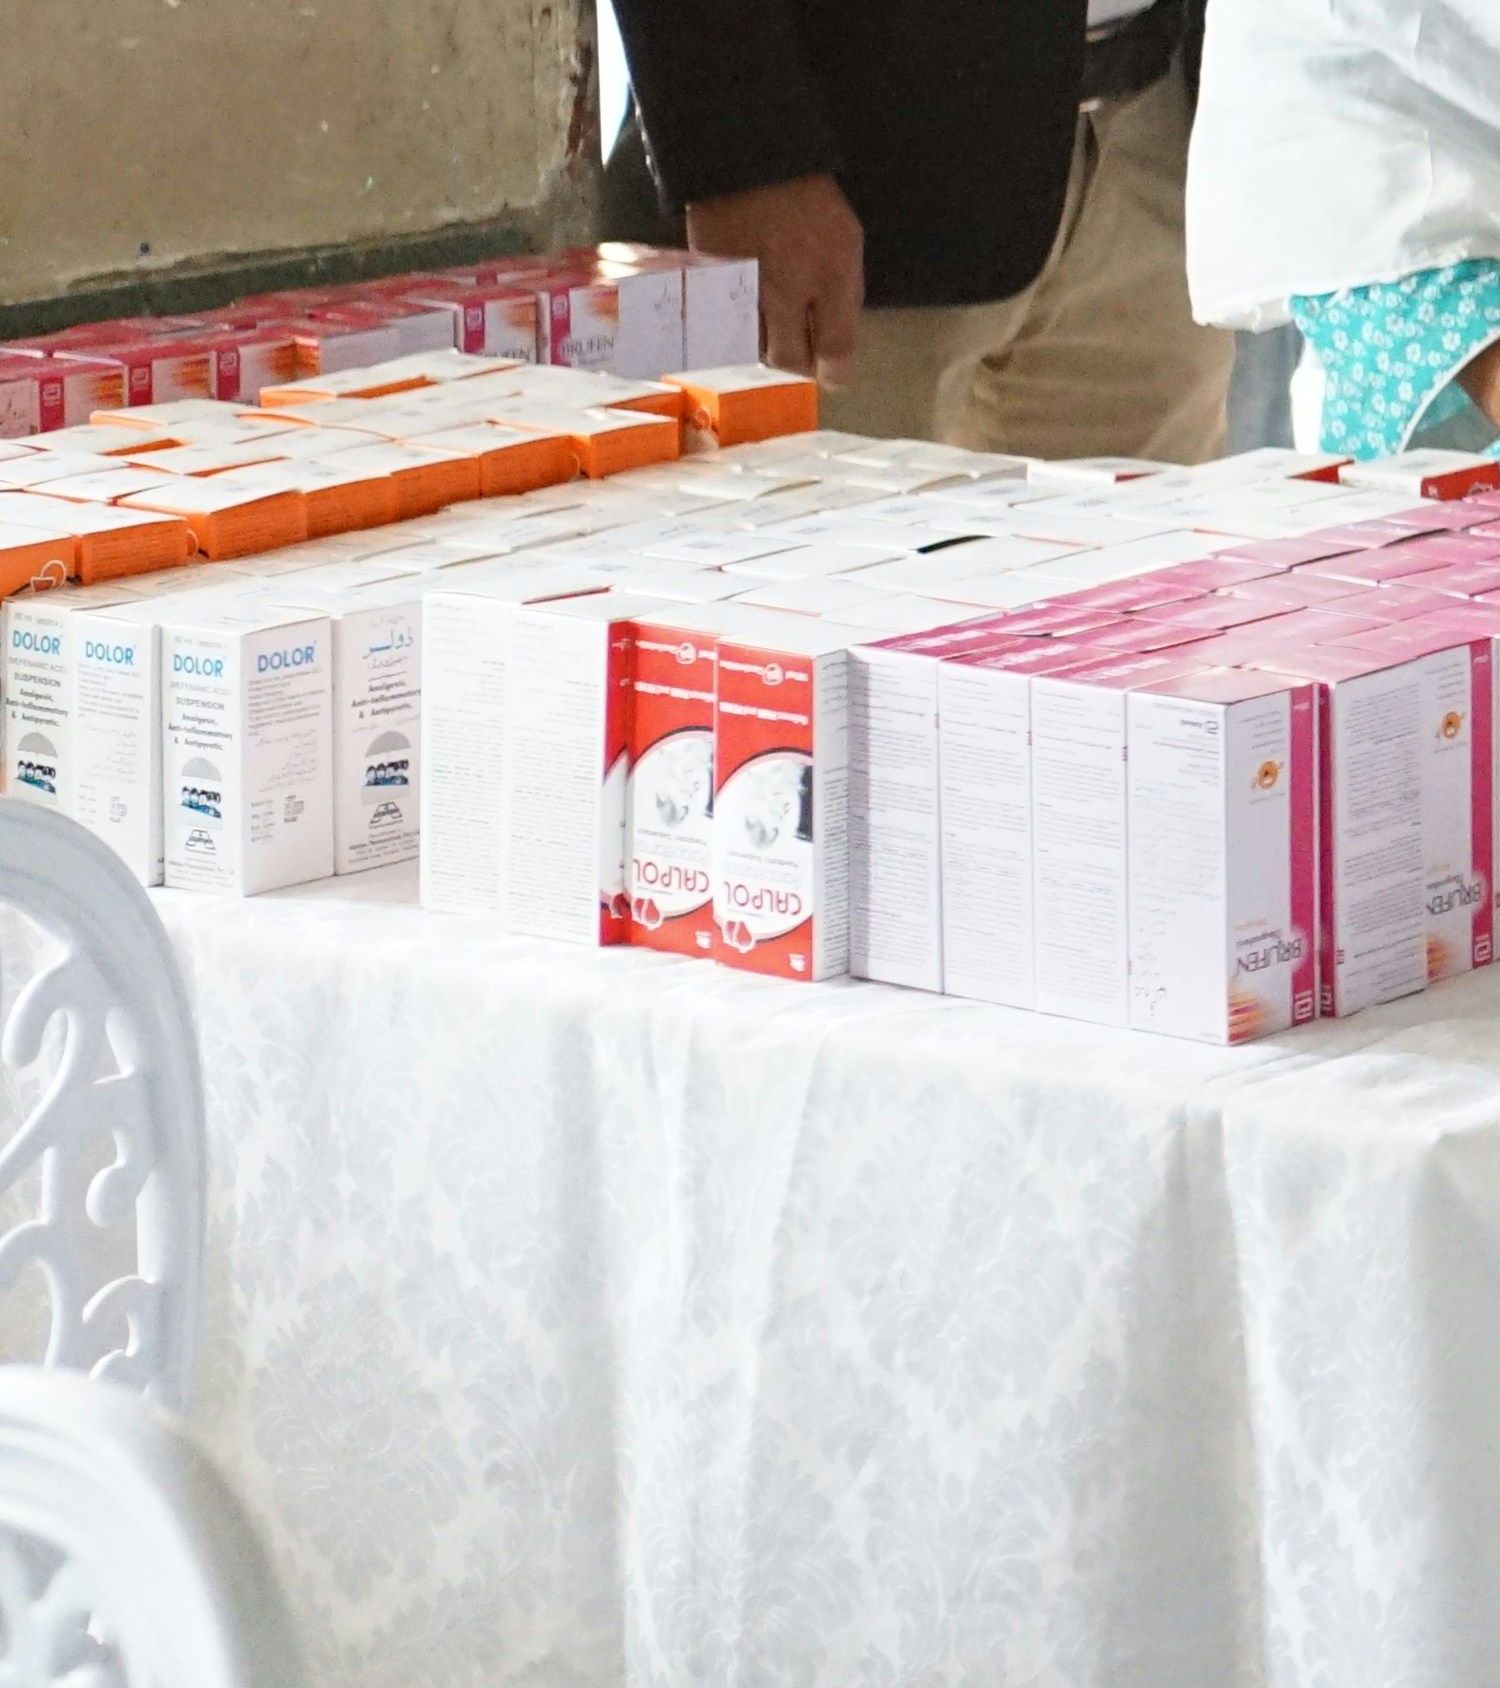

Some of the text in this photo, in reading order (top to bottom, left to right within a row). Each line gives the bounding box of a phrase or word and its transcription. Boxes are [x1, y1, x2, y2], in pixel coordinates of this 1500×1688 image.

[12, 630, 61, 656] DOLOR
[86, 641, 134, 666] DOLOR
[173, 654, 224, 678] DOLOR
[258, 645, 316, 673] DOLOR
[632, 857, 711, 897] CALPOL
[722, 879, 803, 916] CALPOL
[1235, 938, 1304, 976] BRUFEN
